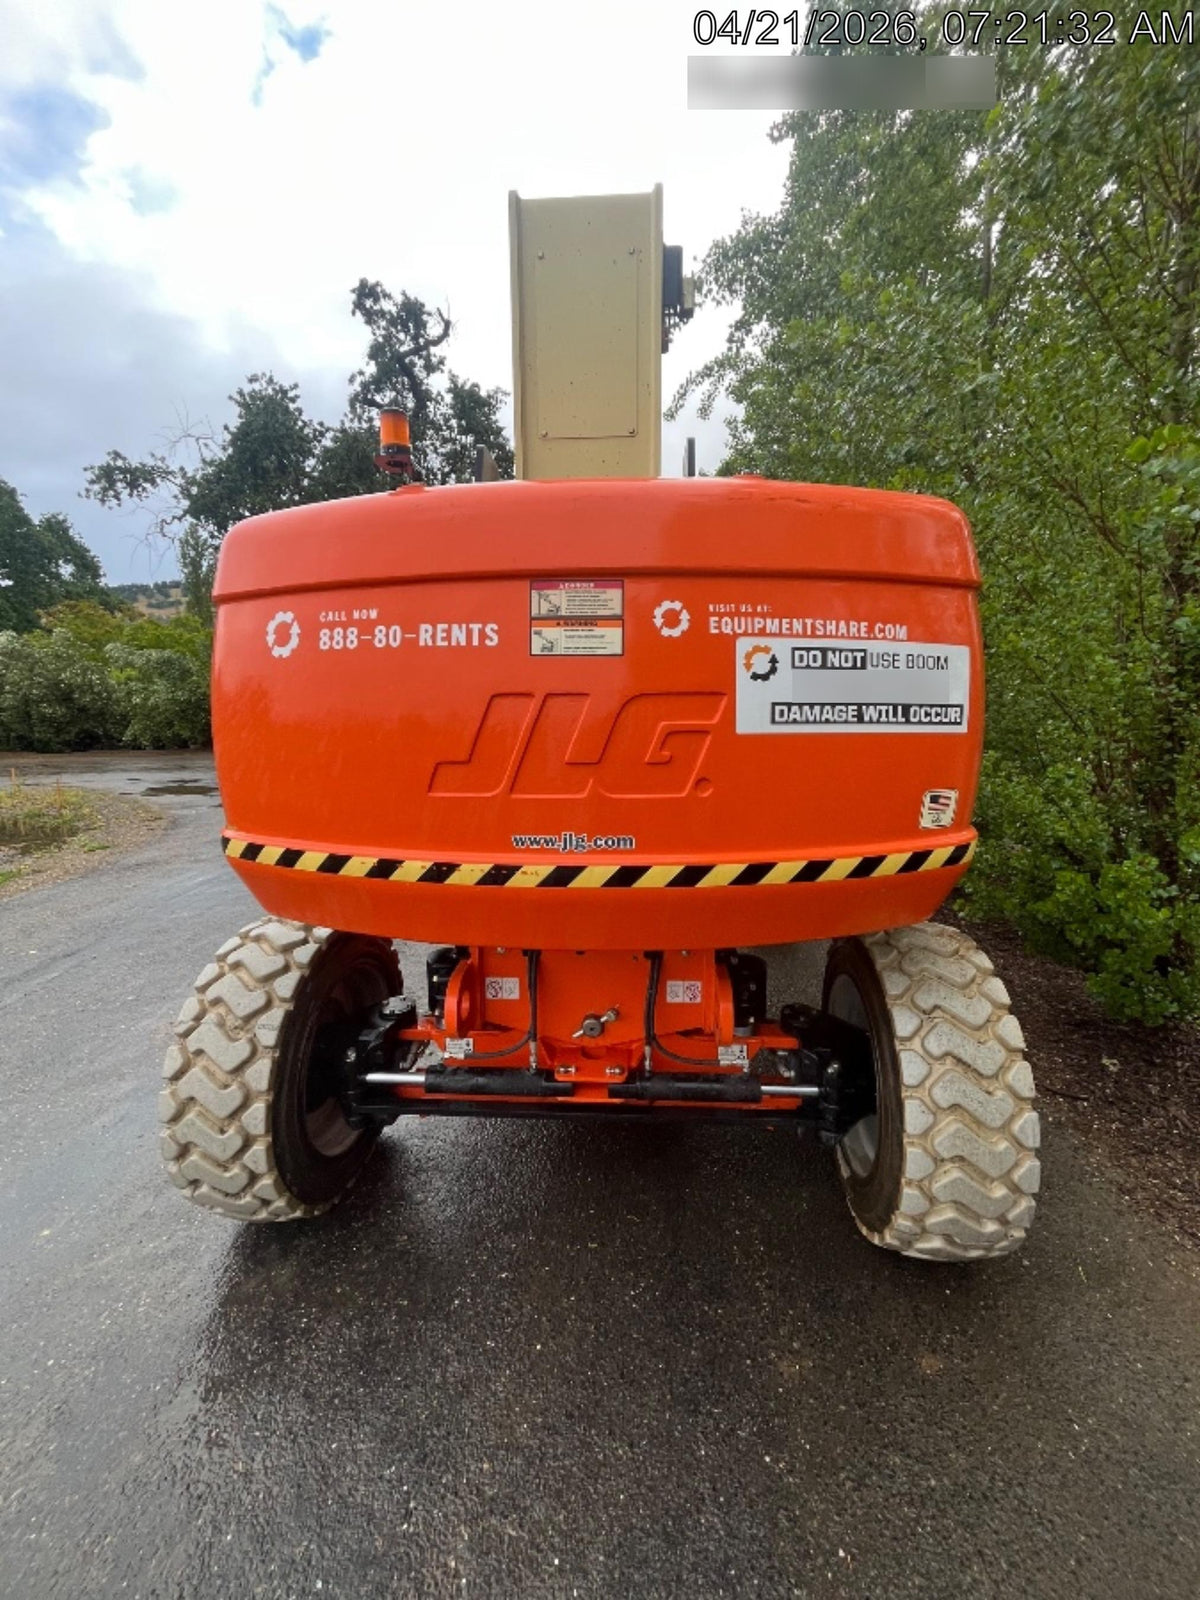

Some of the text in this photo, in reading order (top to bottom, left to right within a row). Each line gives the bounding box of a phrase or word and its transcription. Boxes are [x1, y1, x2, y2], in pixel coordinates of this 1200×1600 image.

[319, 608, 378, 623] CALL NOW
[708, 603, 735, 612] VISIT
[740, 603, 753, 613] US
[319, 623, 499, 650] 888-80-RENTS
[708, 616, 907, 640] EQUIPMENTSHARE.COM
[794, 650, 949, 671] DO NOT USE BOOM
[774, 705, 961, 724] DAMAGE WILL OCCUR
[512, 832, 635, 852] www.jlg.com
